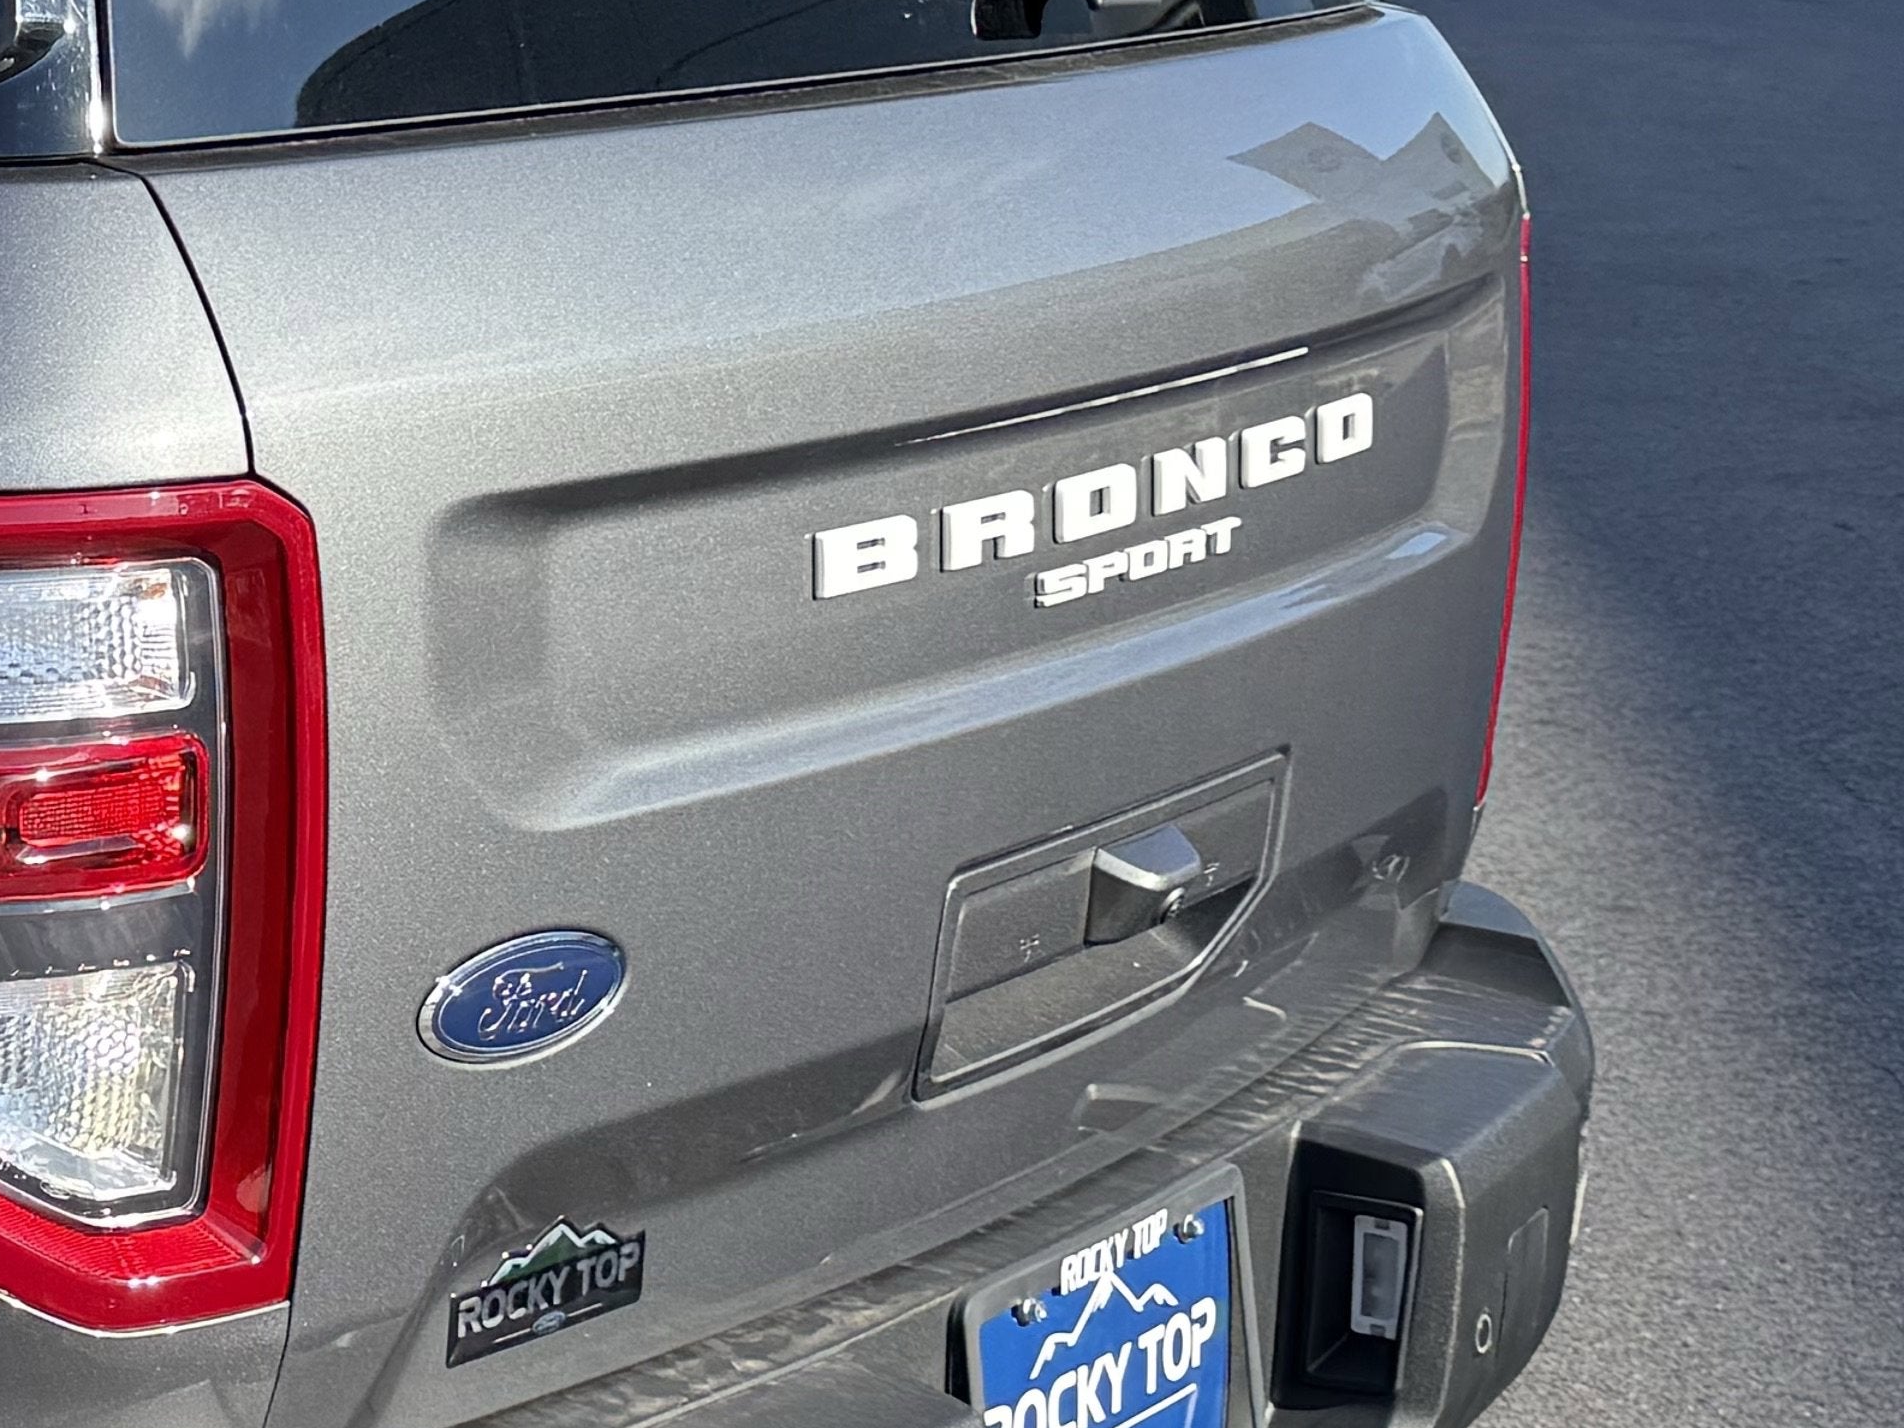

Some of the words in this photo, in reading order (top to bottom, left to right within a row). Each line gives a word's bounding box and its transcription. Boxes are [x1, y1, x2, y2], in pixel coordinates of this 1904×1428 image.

[812, 392, 1374, 600] BRONCO
[1033, 516, 1242, 608] SPORT
[478, 961, 587, 1040] Ford
[456, 1263, 569, 1338] ROCKY
[576, 1241, 640, 1296] TOP
[1060, 1227, 1129, 1295] ROCKY
[1130, 1208, 1167, 1260] TOP
[1138, 1297, 1217, 1395] TOP
